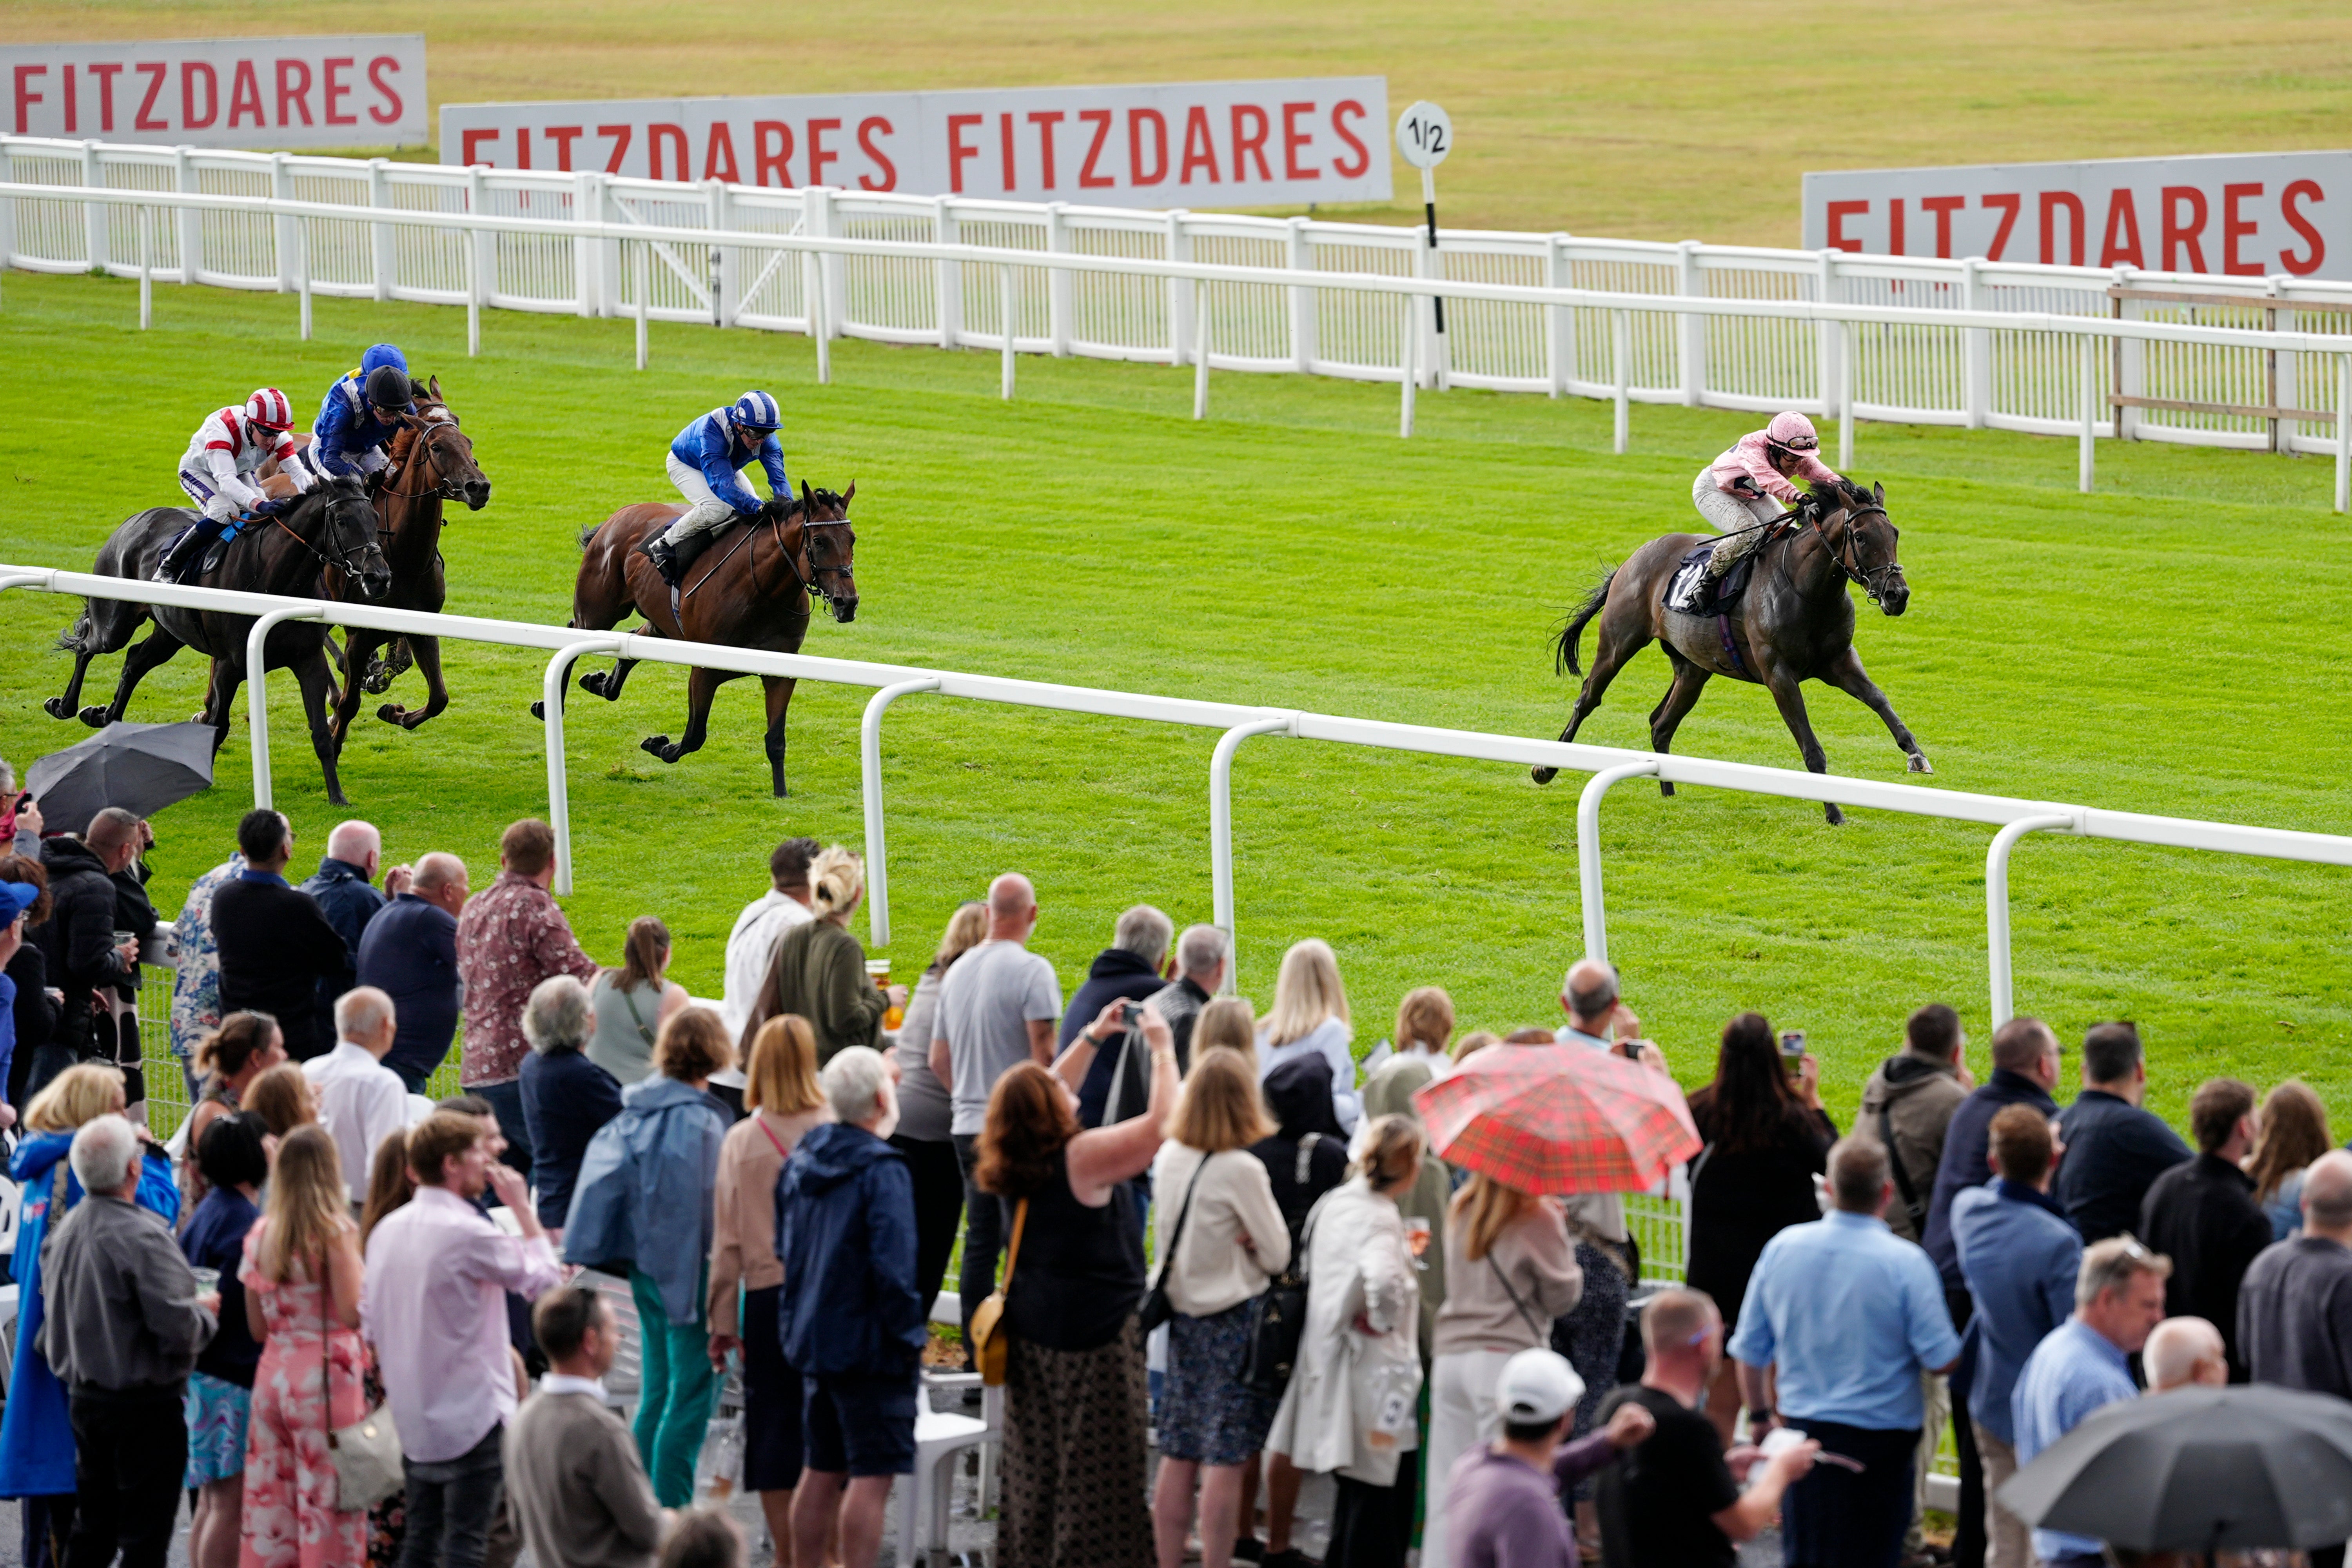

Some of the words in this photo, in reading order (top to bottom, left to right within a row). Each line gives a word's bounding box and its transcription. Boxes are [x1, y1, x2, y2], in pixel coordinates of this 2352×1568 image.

[14, 56, 403, 133] FITZDARES
[1408, 117, 1446, 154] 1/2
[947, 99, 1370, 193] FITZDARES
[1827, 179, 2325, 293] FITZDARES
